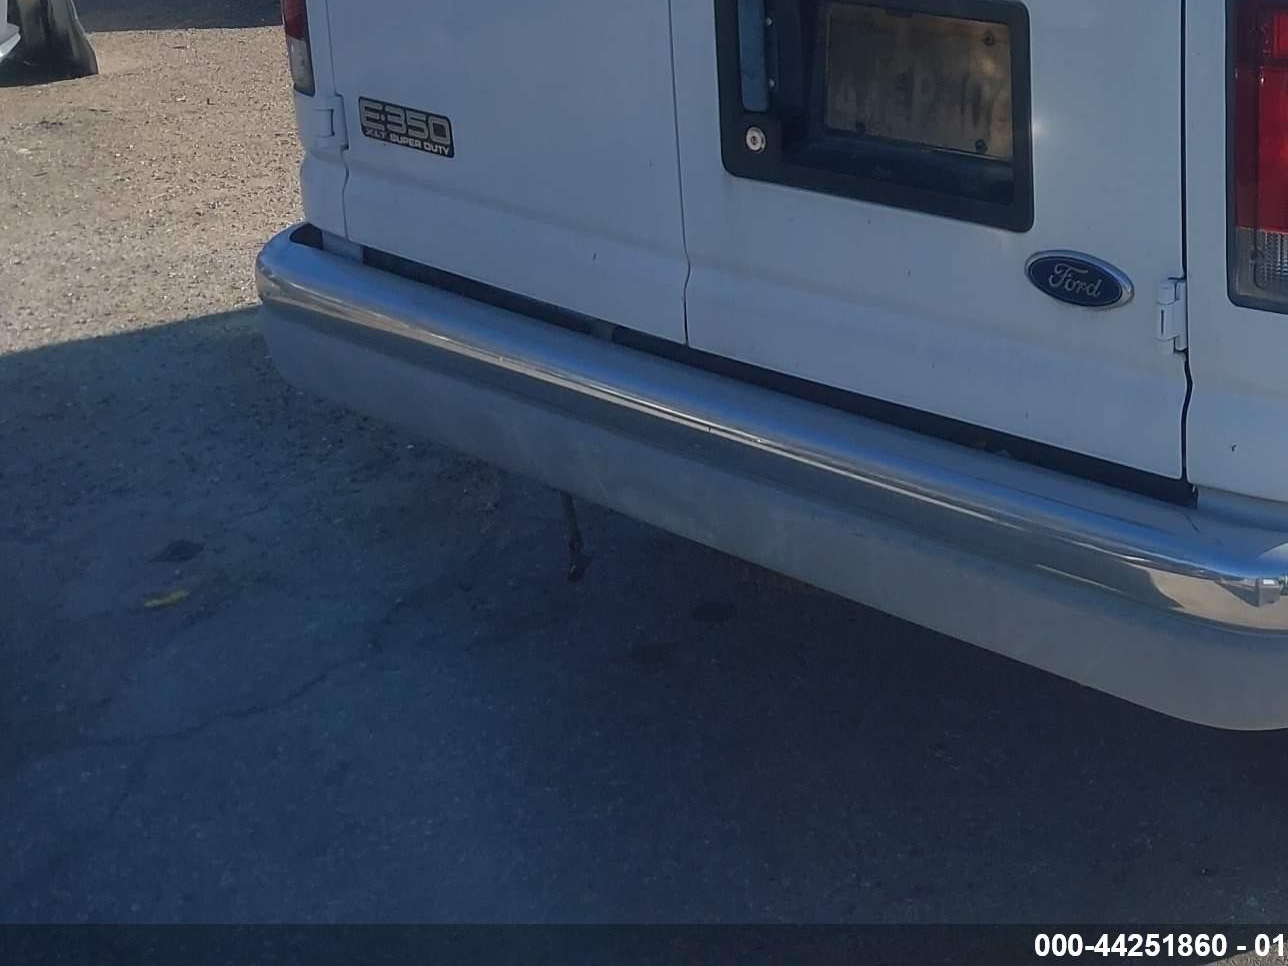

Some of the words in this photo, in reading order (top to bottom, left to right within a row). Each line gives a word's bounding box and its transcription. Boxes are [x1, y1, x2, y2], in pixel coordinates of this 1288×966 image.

[391, 133, 422, 148] SUPER
[424, 141, 449, 155] DUTY
[1048, 262, 1103, 297] Ford
